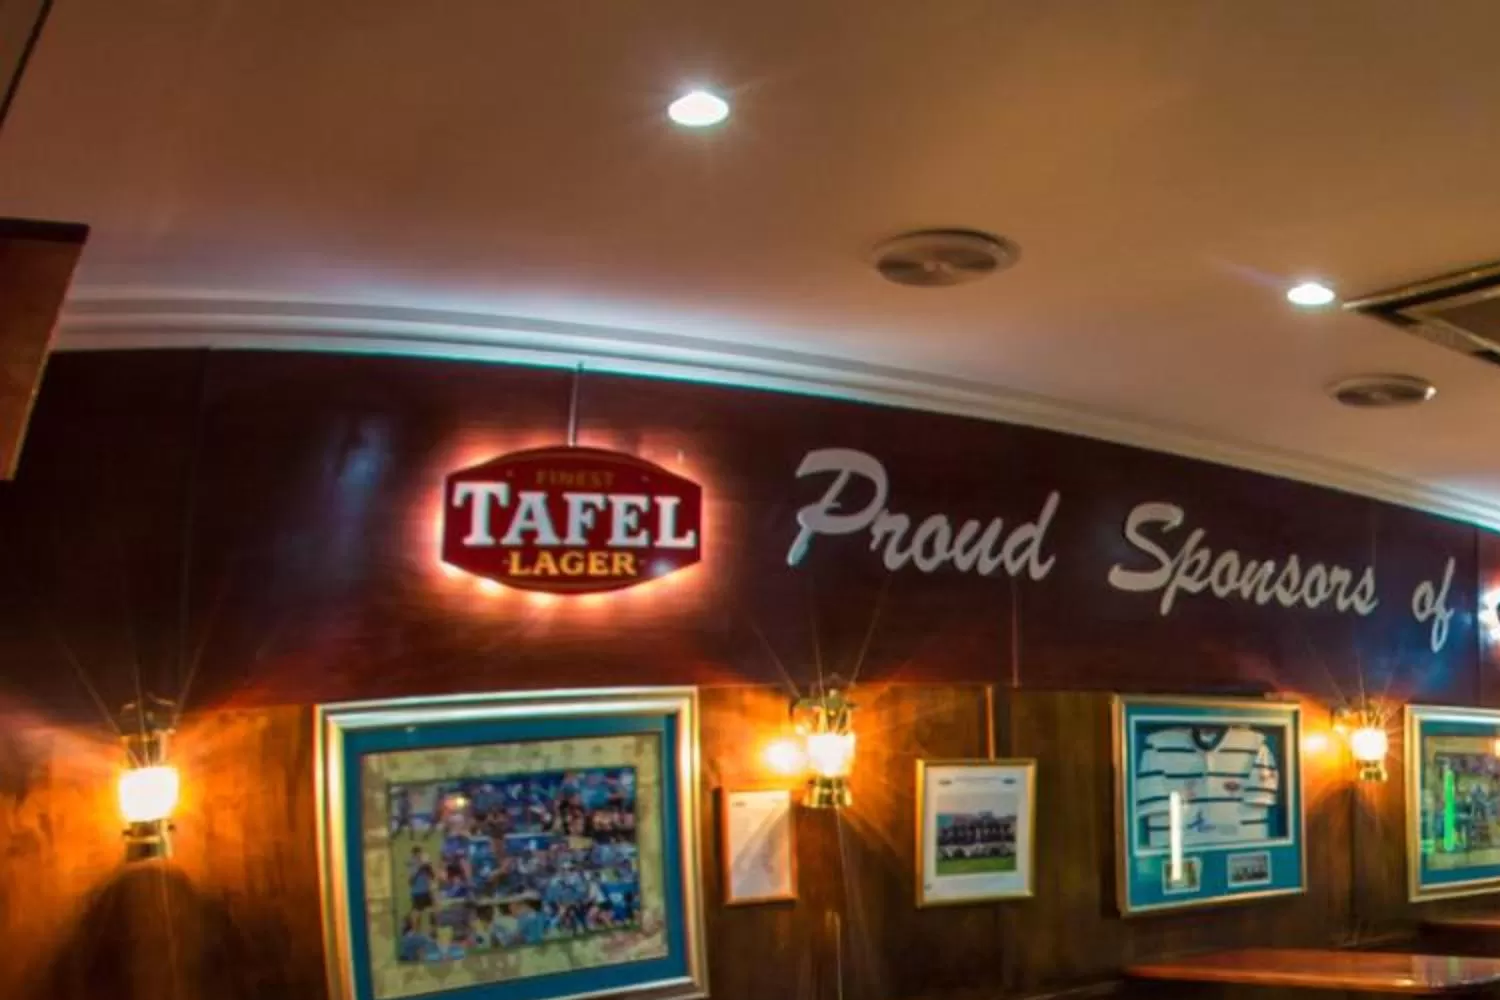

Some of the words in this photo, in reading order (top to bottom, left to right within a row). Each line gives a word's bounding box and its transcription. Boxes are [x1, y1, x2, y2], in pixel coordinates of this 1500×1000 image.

[536, 470, 615, 488] FINEST
[452, 481, 697, 549] TAFEL
[509, 551, 637, 577] LAGER
[787, 447, 1061, 581] Proud
[1107, 502, 1380, 617] Sponsors
[1411, 556, 1455, 654] of
